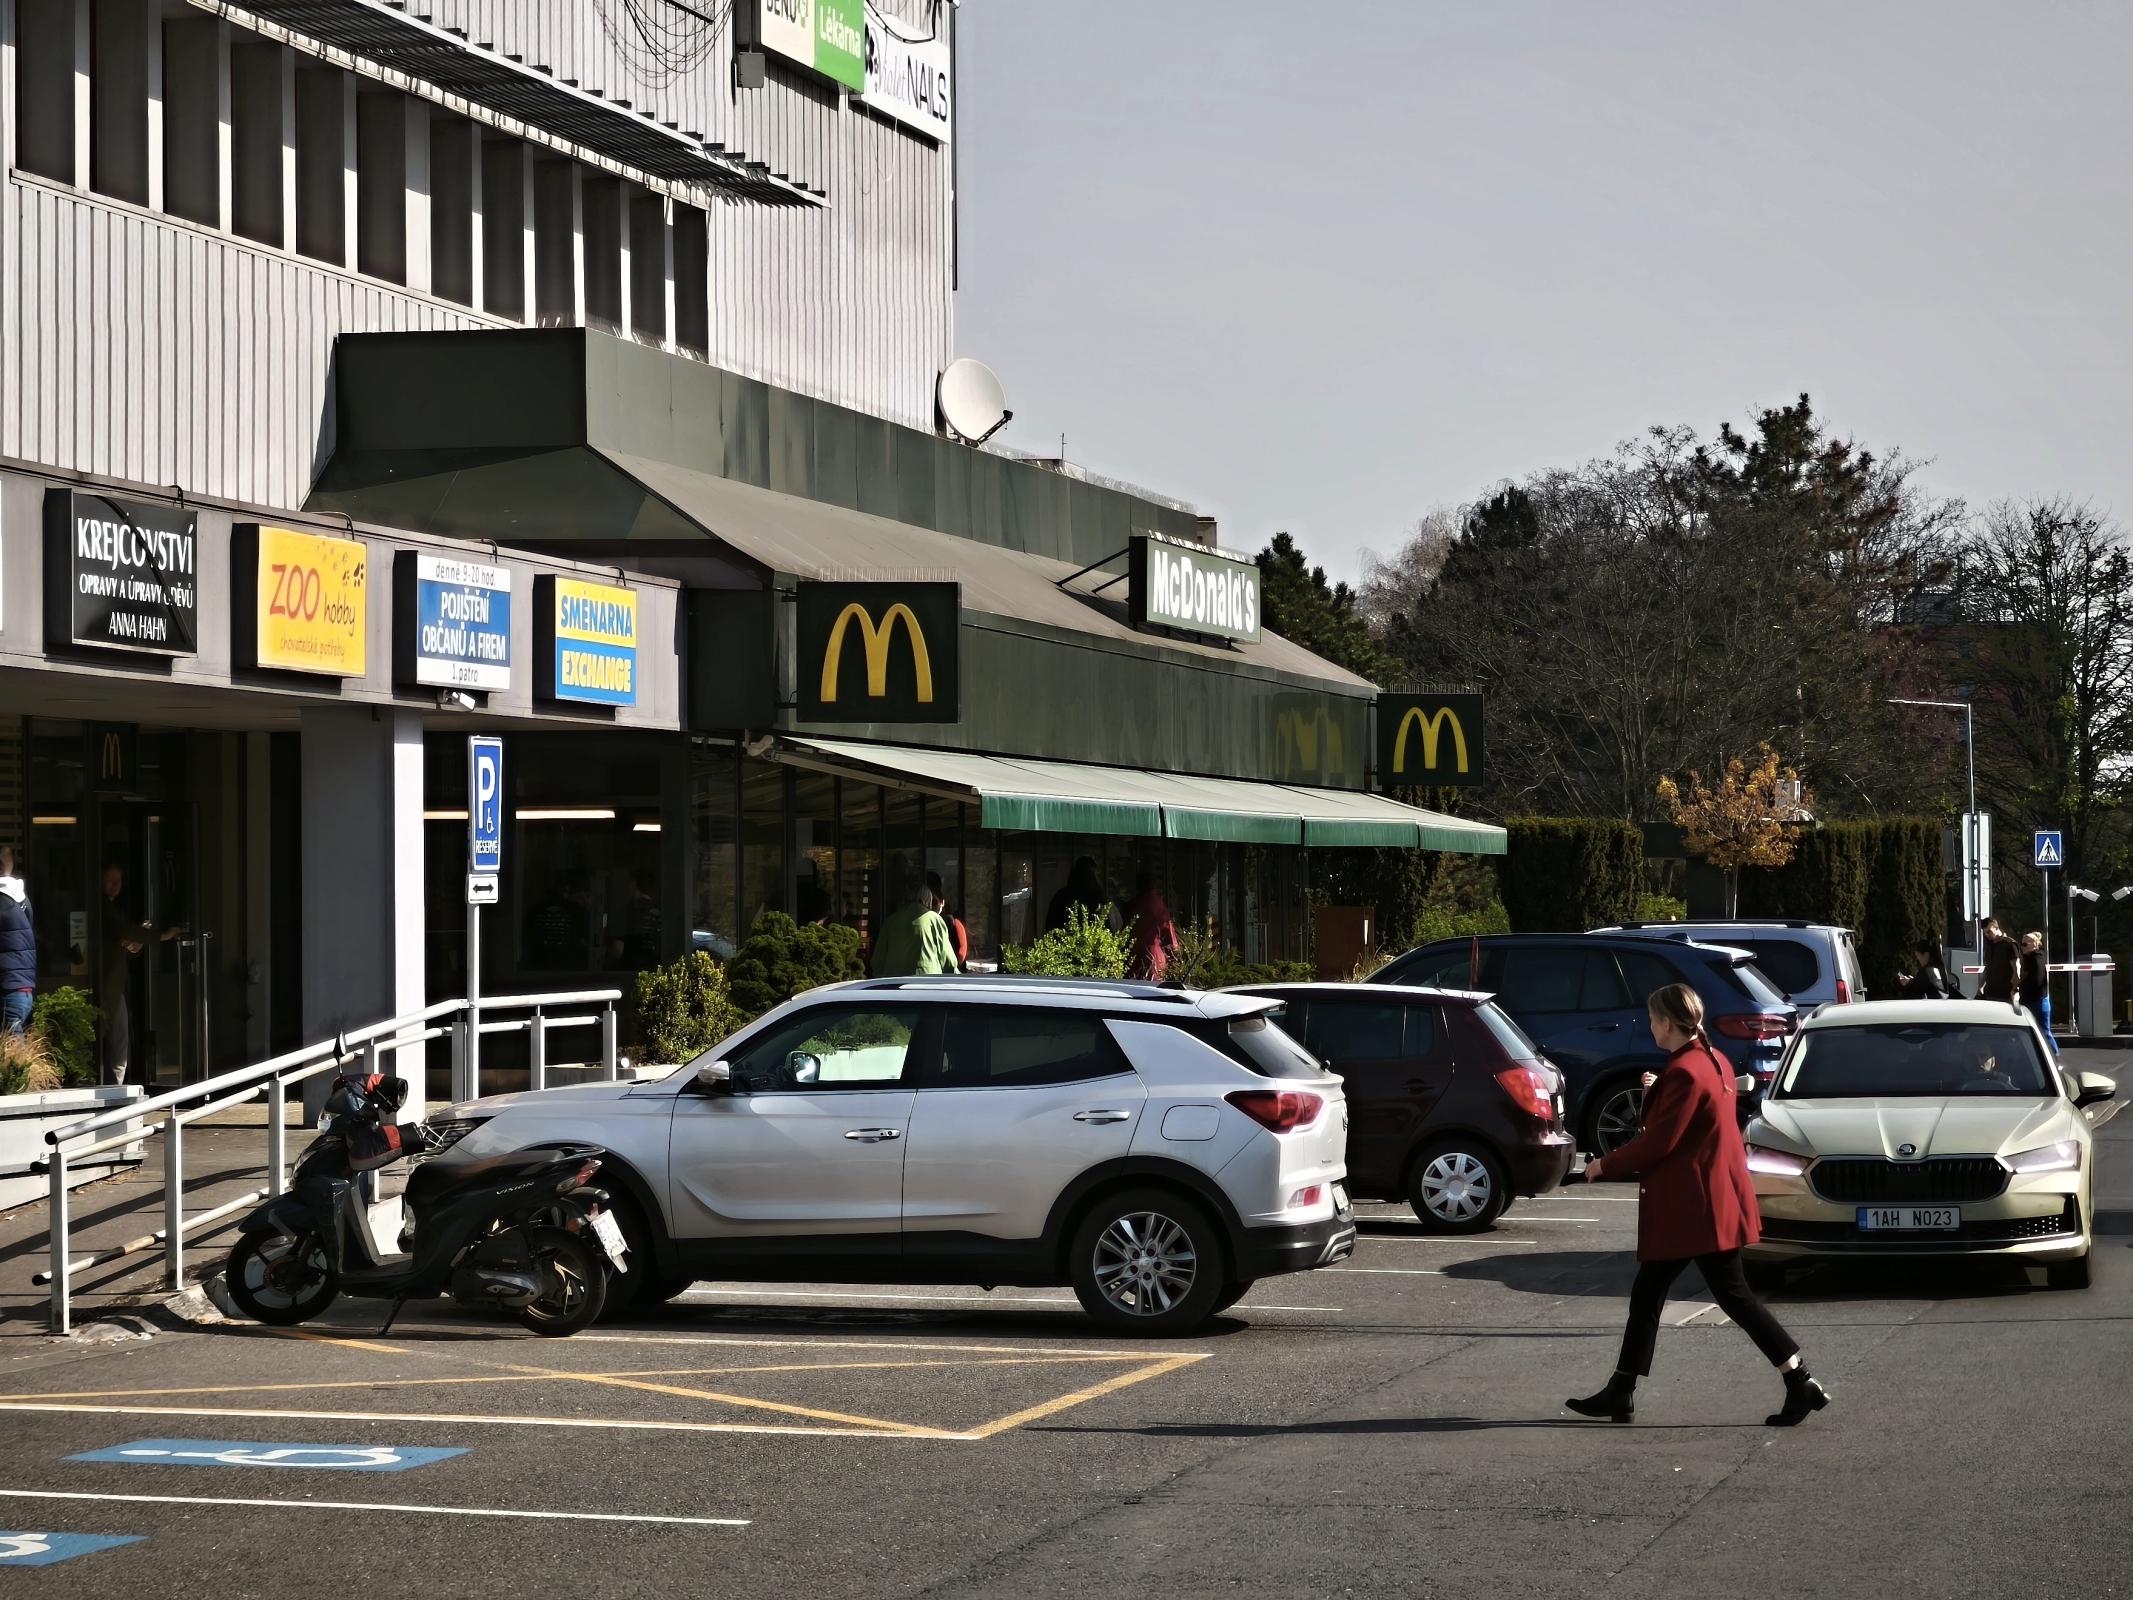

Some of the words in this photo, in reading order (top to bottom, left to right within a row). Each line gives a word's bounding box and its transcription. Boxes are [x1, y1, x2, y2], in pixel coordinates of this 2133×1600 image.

[820, 5, 862, 59] Lékárna
[907, 53, 948, 123] NAILS
[79, 573, 118, 598] OPRAVY
[119, 579, 127, 599] A
[128, 574, 162, 604] ÚPRAVY
[269, 564, 321, 623] ZOO
[323, 592, 357, 638] hobby
[441, 587, 490, 624] POJIŠTĚNÍ
[1153, 549, 1255, 633] McDonald's
[108, 611, 137, 638] ANNA
[139, 614, 167, 642] HAHN
[422, 619, 467, 657] OBČANŮ
[468, 631, 476, 658] A
[478, 632, 506, 661] FIREM
[561, 649, 632, 693] EXCHANGE
[478, 756, 496, 829] P
[1872, 1210, 1900, 1228] 1AH
[1912, 1210, 1952, 1227] N023
